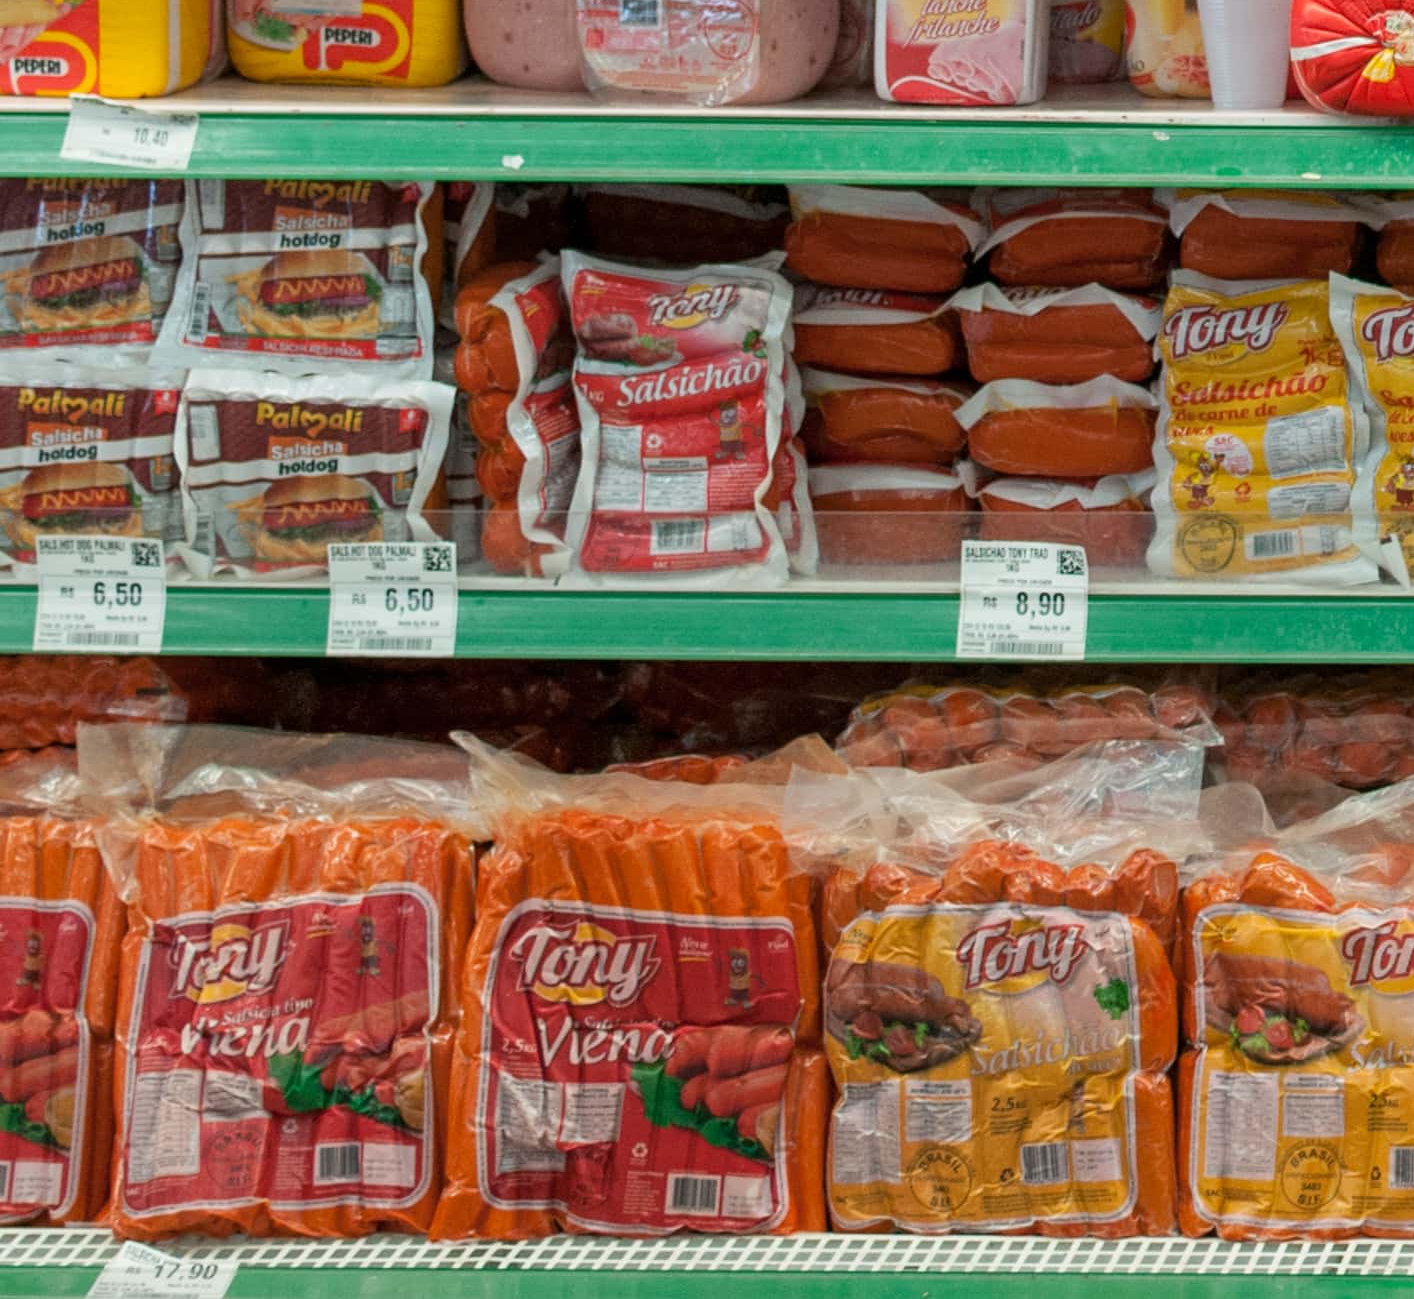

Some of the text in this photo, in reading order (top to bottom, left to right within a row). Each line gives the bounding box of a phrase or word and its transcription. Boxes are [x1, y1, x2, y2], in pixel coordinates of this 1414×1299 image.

[279, 231, 341, 250] hotdog
[1166, 300, 1285, 358] Tony
[616, 352, 763, 408] Salsichão
[1172, 370, 1328, 408] Salsichão
[18, 388, 124, 423] Palmali
[1008, 547, 1027, 558] TONY
[93, 582, 142, 609] 6,50
[385, 588, 434, 615] 6,50
[1016, 591, 1065, 619] 8,90
[513, 924, 660, 1000] Tony
[958, 922, 1088, 989] Tony
[536, 1017, 675, 1069] Viena
[970, 1025, 1123, 1077] Salsichão
[154, 1263, 218, 1281] 17,90
